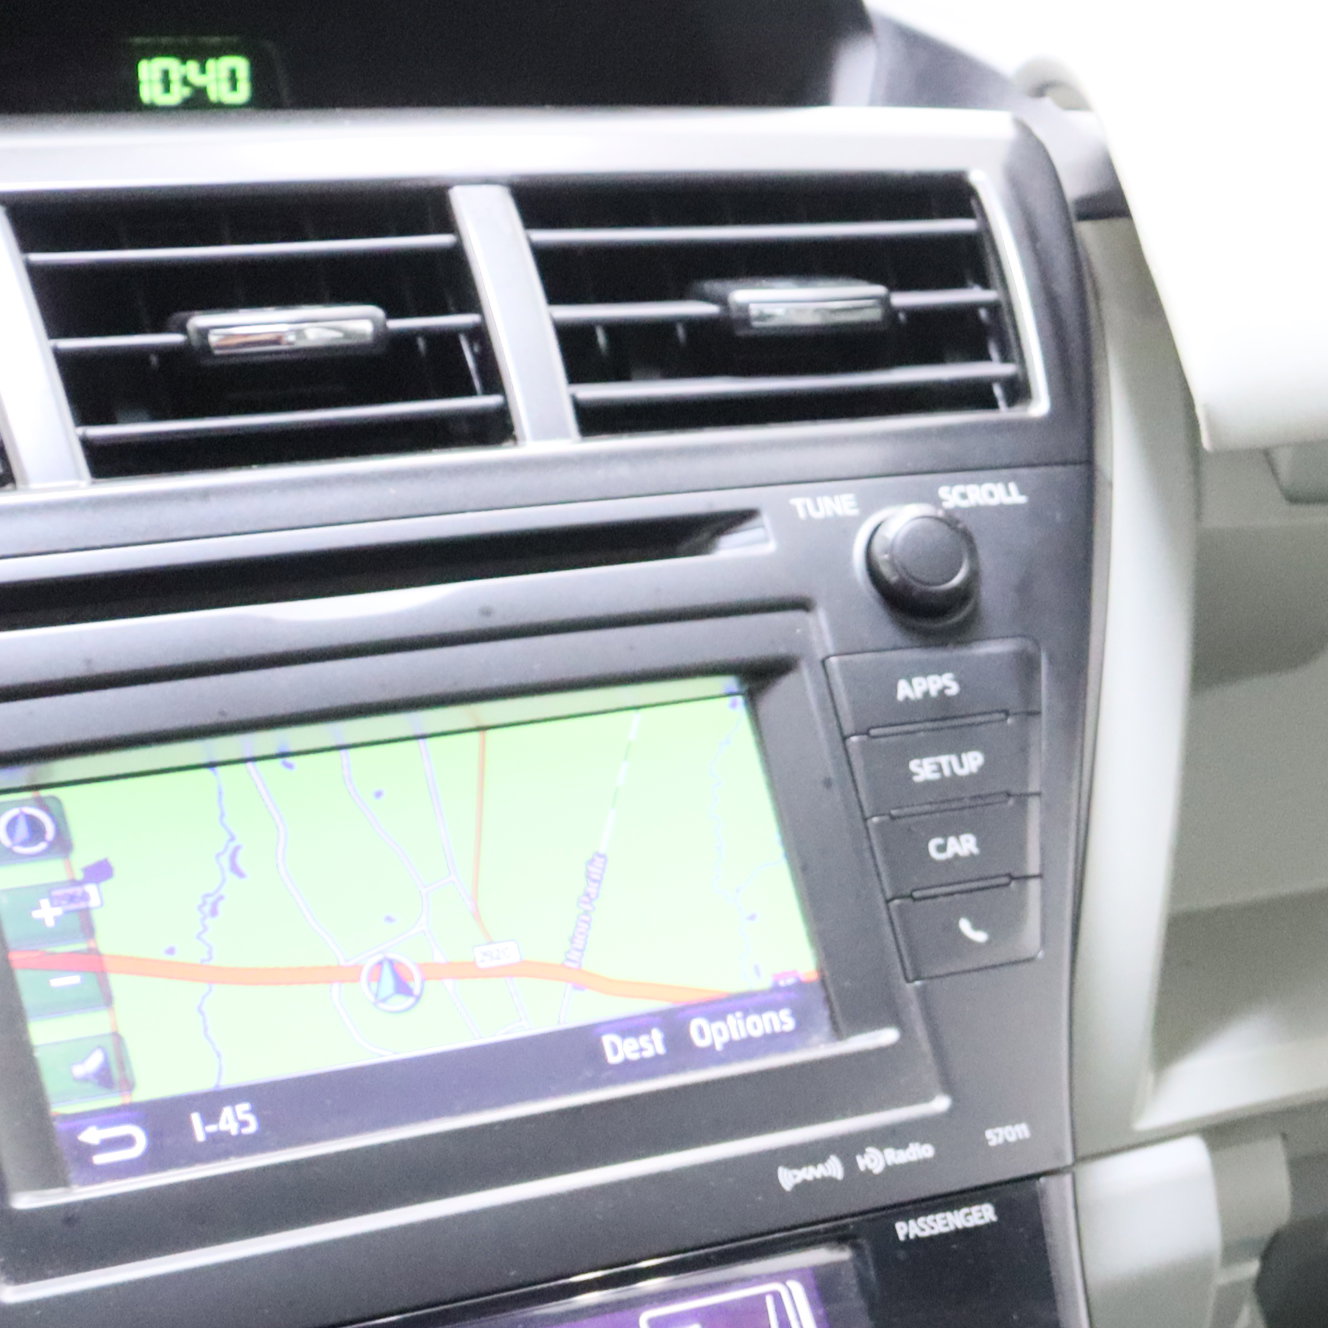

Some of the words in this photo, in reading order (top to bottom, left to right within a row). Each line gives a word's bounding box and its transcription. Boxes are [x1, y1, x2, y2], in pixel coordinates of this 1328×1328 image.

[138, 55, 251, 107] 10:40
[790, 494, 859, 520] TUNE
[938, 481, 1028, 509] SCROLL
[896, 672, 959, 702] APPS
[908, 750, 984, 783] SETUP
[927, 833, 980, 862] CAR
[601, 1025, 667, 1065] Dest
[689, 1007, 796, 1051] Options
[985, 1122, 1031, 1147] 57011
[884, 1142, 935, 1166] Radio
[895, 1202, 998, 1242] PASSENGER
